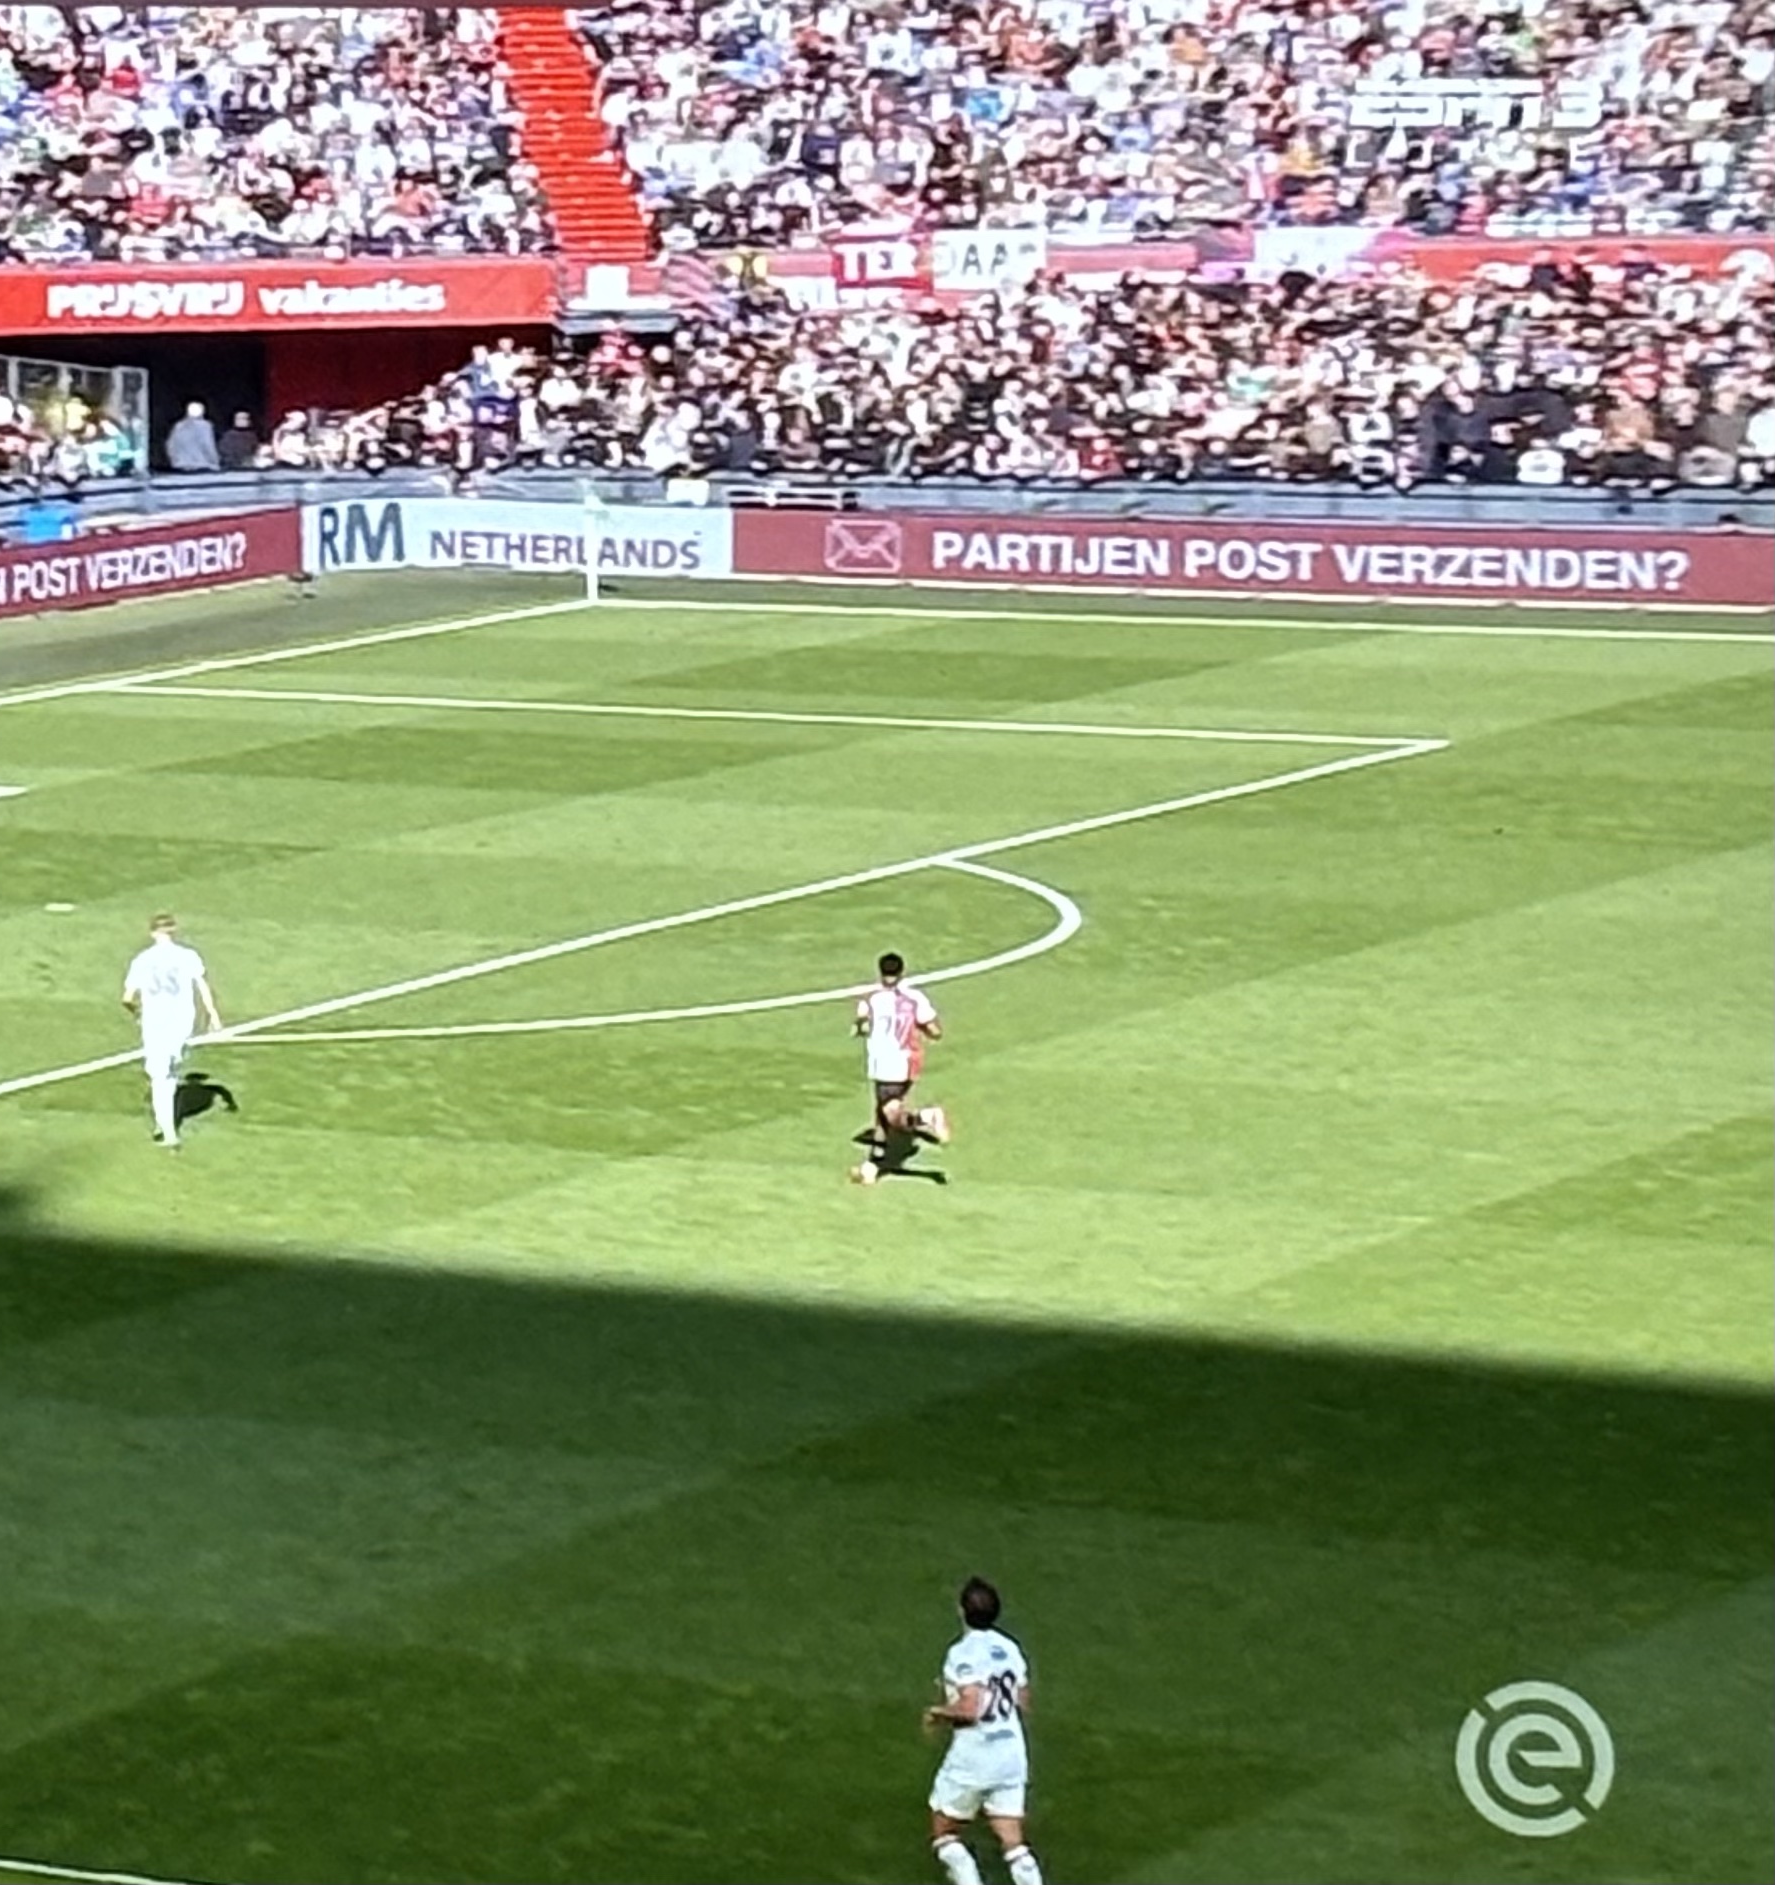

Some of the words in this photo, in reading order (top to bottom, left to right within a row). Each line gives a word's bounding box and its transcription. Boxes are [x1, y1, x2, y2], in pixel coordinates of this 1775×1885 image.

[257, 278, 446, 316] vakanties
[318, 501, 406, 569] RM
[429, 530, 701, 570] NETHERLANDS
[931, 530, 1171, 577] PARTIJEN
[1182, 539, 1324, 581] POST
[1330, 543, 1691, 591] VERZENDEN?
[13, 556, 81, 602] POST
[85, 531, 247, 590] VERZENDEN?
[980, 1670, 1017, 1722] 28
